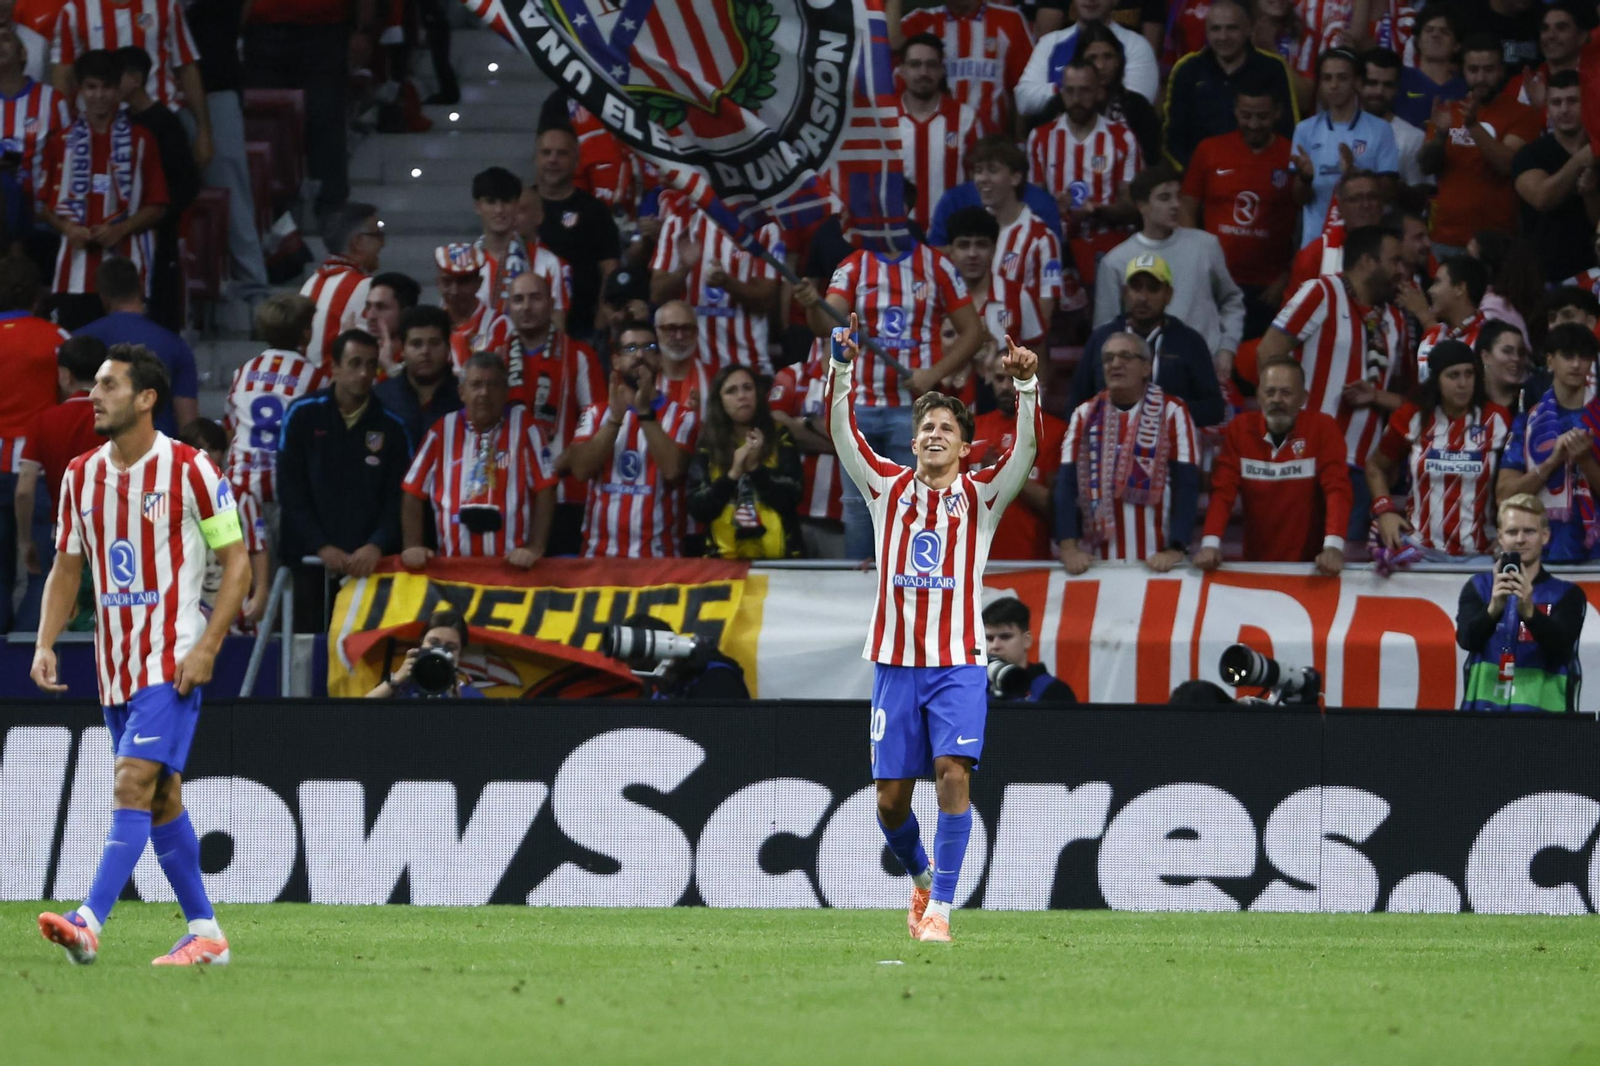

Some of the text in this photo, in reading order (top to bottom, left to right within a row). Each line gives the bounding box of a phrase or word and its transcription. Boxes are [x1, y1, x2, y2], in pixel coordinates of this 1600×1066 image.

[601, 95, 644, 141] EL
[250, 394, 284, 451] 8
[1438, 450, 1472, 461] Trade
[1426, 461, 1481, 473] Plus500
[894, 575, 954, 588] RIYADH AIR
[102, 591, 158, 606] RIYADH AIR
[0, 726, 1600, 914] llowScores.c
